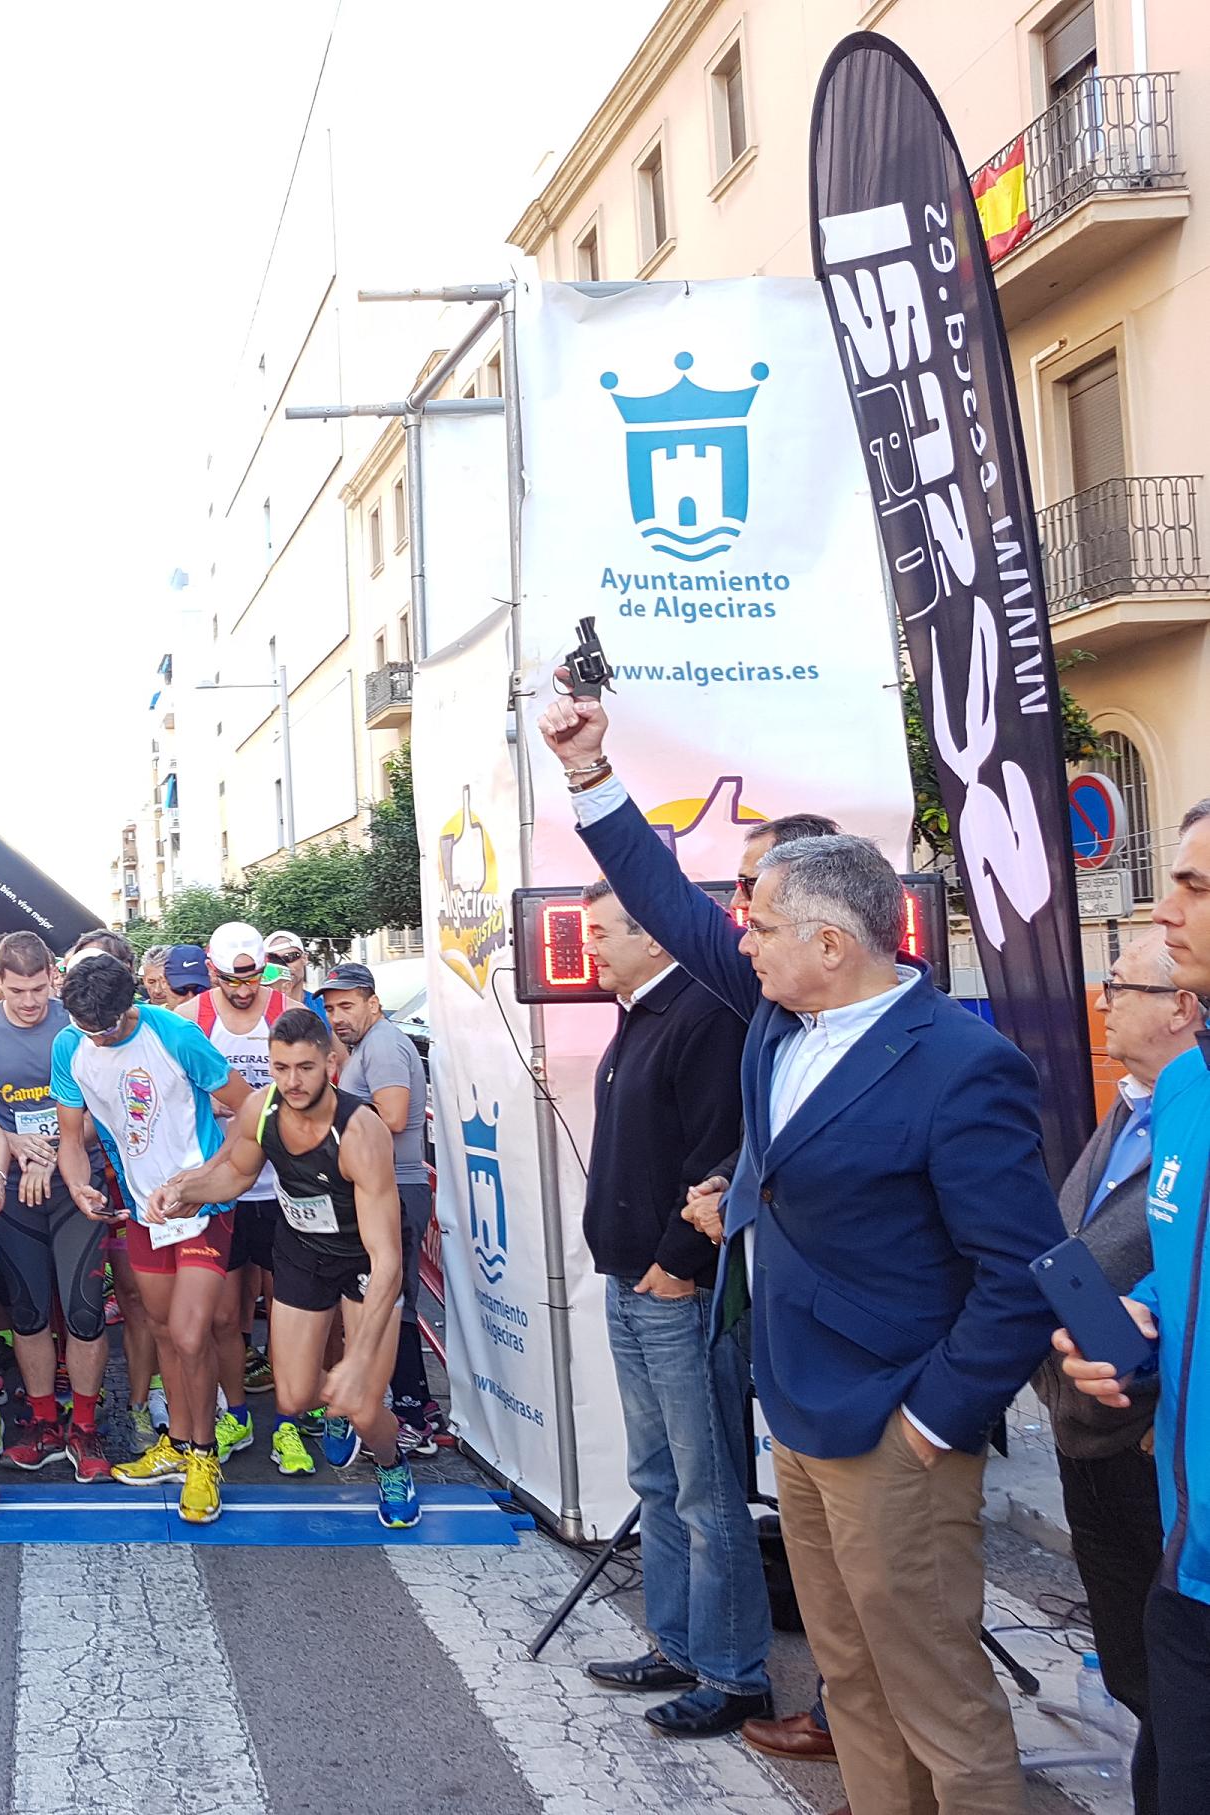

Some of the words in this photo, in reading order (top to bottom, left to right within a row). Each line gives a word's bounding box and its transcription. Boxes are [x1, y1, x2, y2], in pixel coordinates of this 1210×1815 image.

[601, 568, 790, 595] Ayuntamiento
[619, 599, 646, 617] de
[654, 597, 776, 623] Algeciras
[0, 884, 17, 903] bien,
[17, 899, 33, 914] vive
[30, 911, 54, 929] mejor
